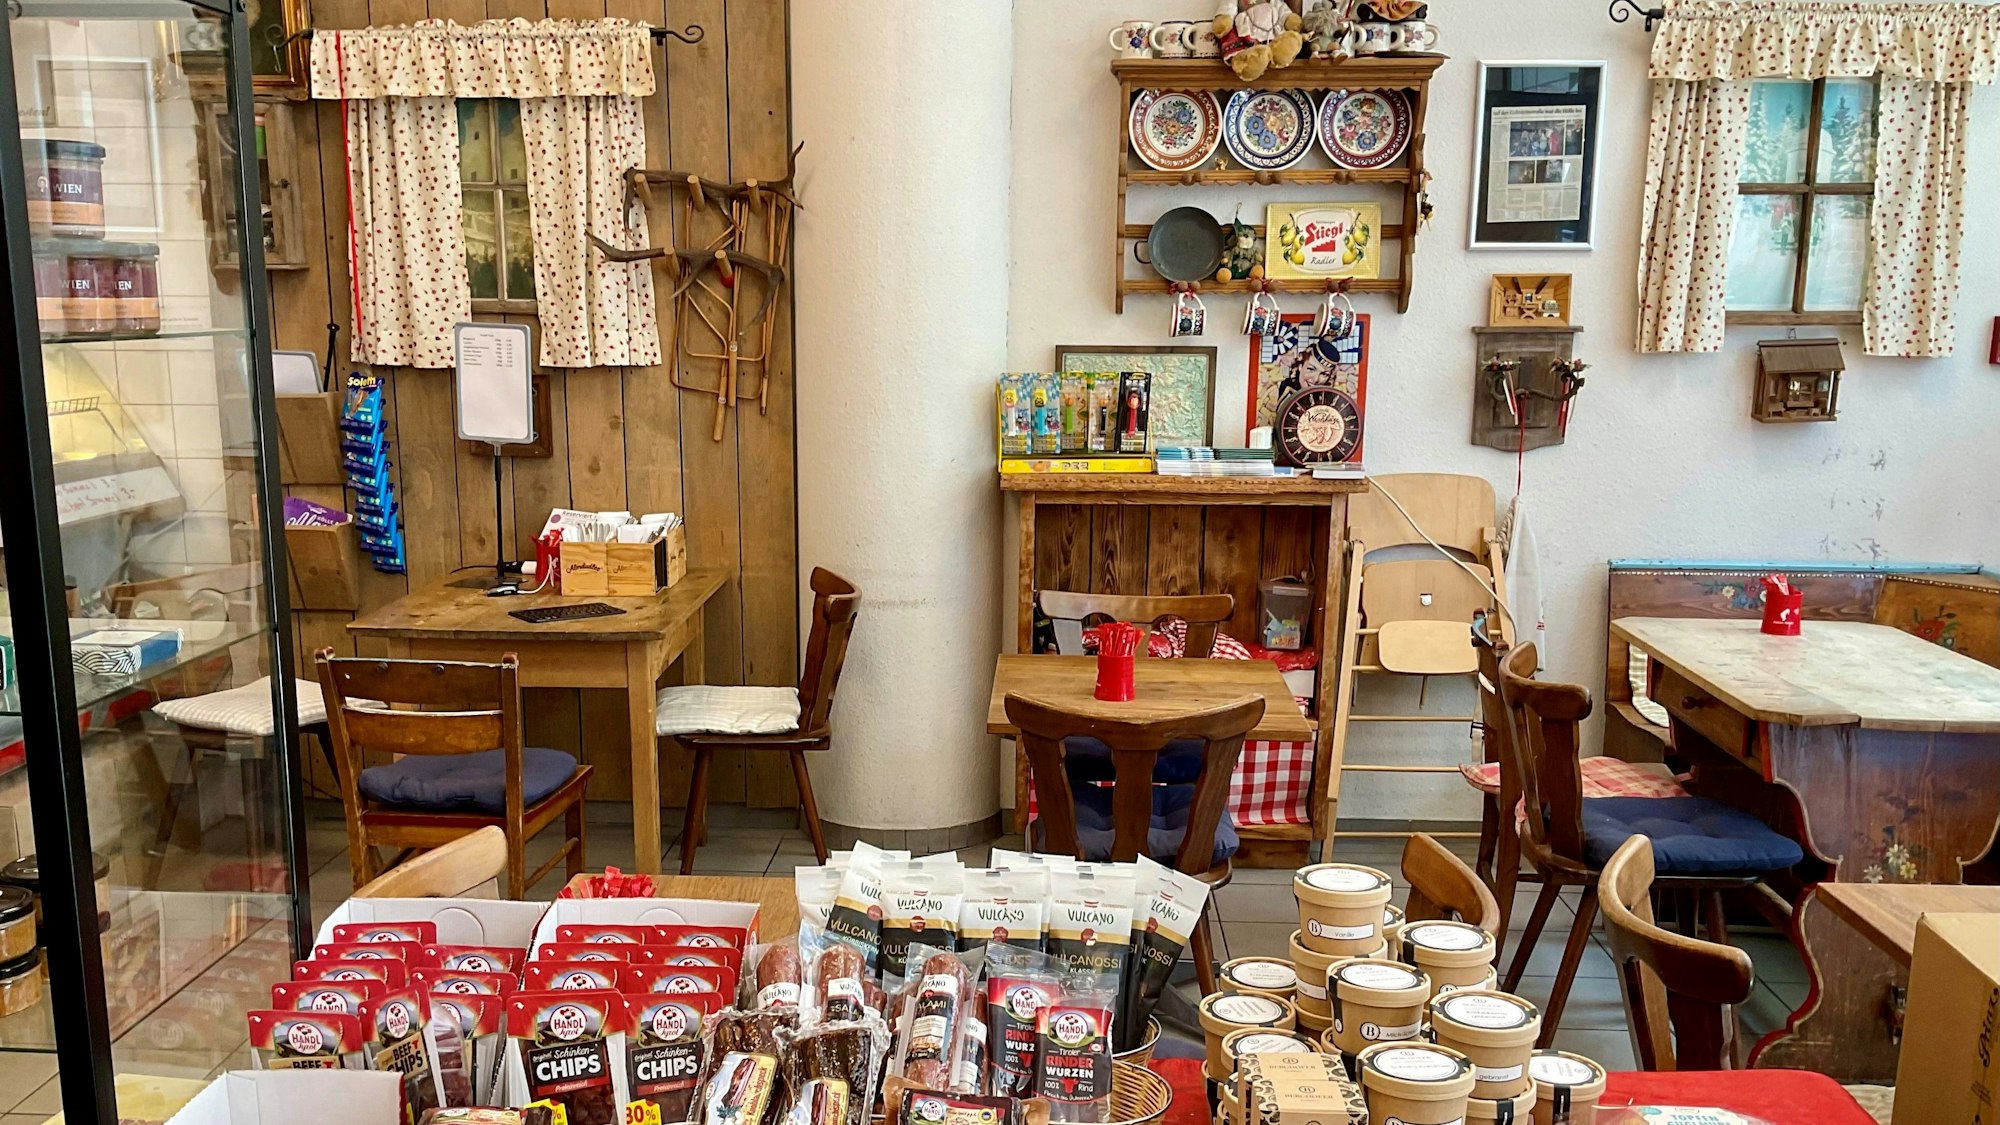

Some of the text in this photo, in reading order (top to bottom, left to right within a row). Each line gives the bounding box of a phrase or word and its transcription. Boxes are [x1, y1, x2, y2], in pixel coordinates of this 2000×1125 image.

[1304, 221, 1344, 246] Stiegl
[1310, 256, 1336, 265] Radler
[1062, 461, 1089, 471] PEZ
[860, 882, 882, 900] VULC
[978, 907, 1025, 923] VULCANO
[1067, 907, 1115, 924] VULCANO
[1150, 903, 1179, 922] LCANO
[830, 918, 883, 945] VULCANO
[1015, 998, 1036, 1008] HAND
[388, 1014, 409, 1028] HANDL
[554, 1017, 584, 1030] HANDL
[656, 1018, 684, 1030] HANDL
[1977, 987, 2000, 1068] Prinz
[1005, 1029, 1035, 1042] RIND
[1059, 1026, 1085, 1035] HANDL
[291, 1032, 321, 1046] HANDL
[392, 1041, 413, 1061] BEEF
[553, 1045, 596, 1058] Schinken-
[654, 1045, 694, 1058] Schinken-
[1005, 1040, 1035, 1052] WURZ
[1059, 1048, 1081, 1056] Tiroler
[536, 1054, 602, 1081] CHIPS
[637, 1055, 698, 1081] CHIPS
[1046, 1055, 1094, 1069] RINDER
[1045, 1066, 1094, 1079] WURZEN
[1044, 1080, 1094, 1093] 100% Rind
